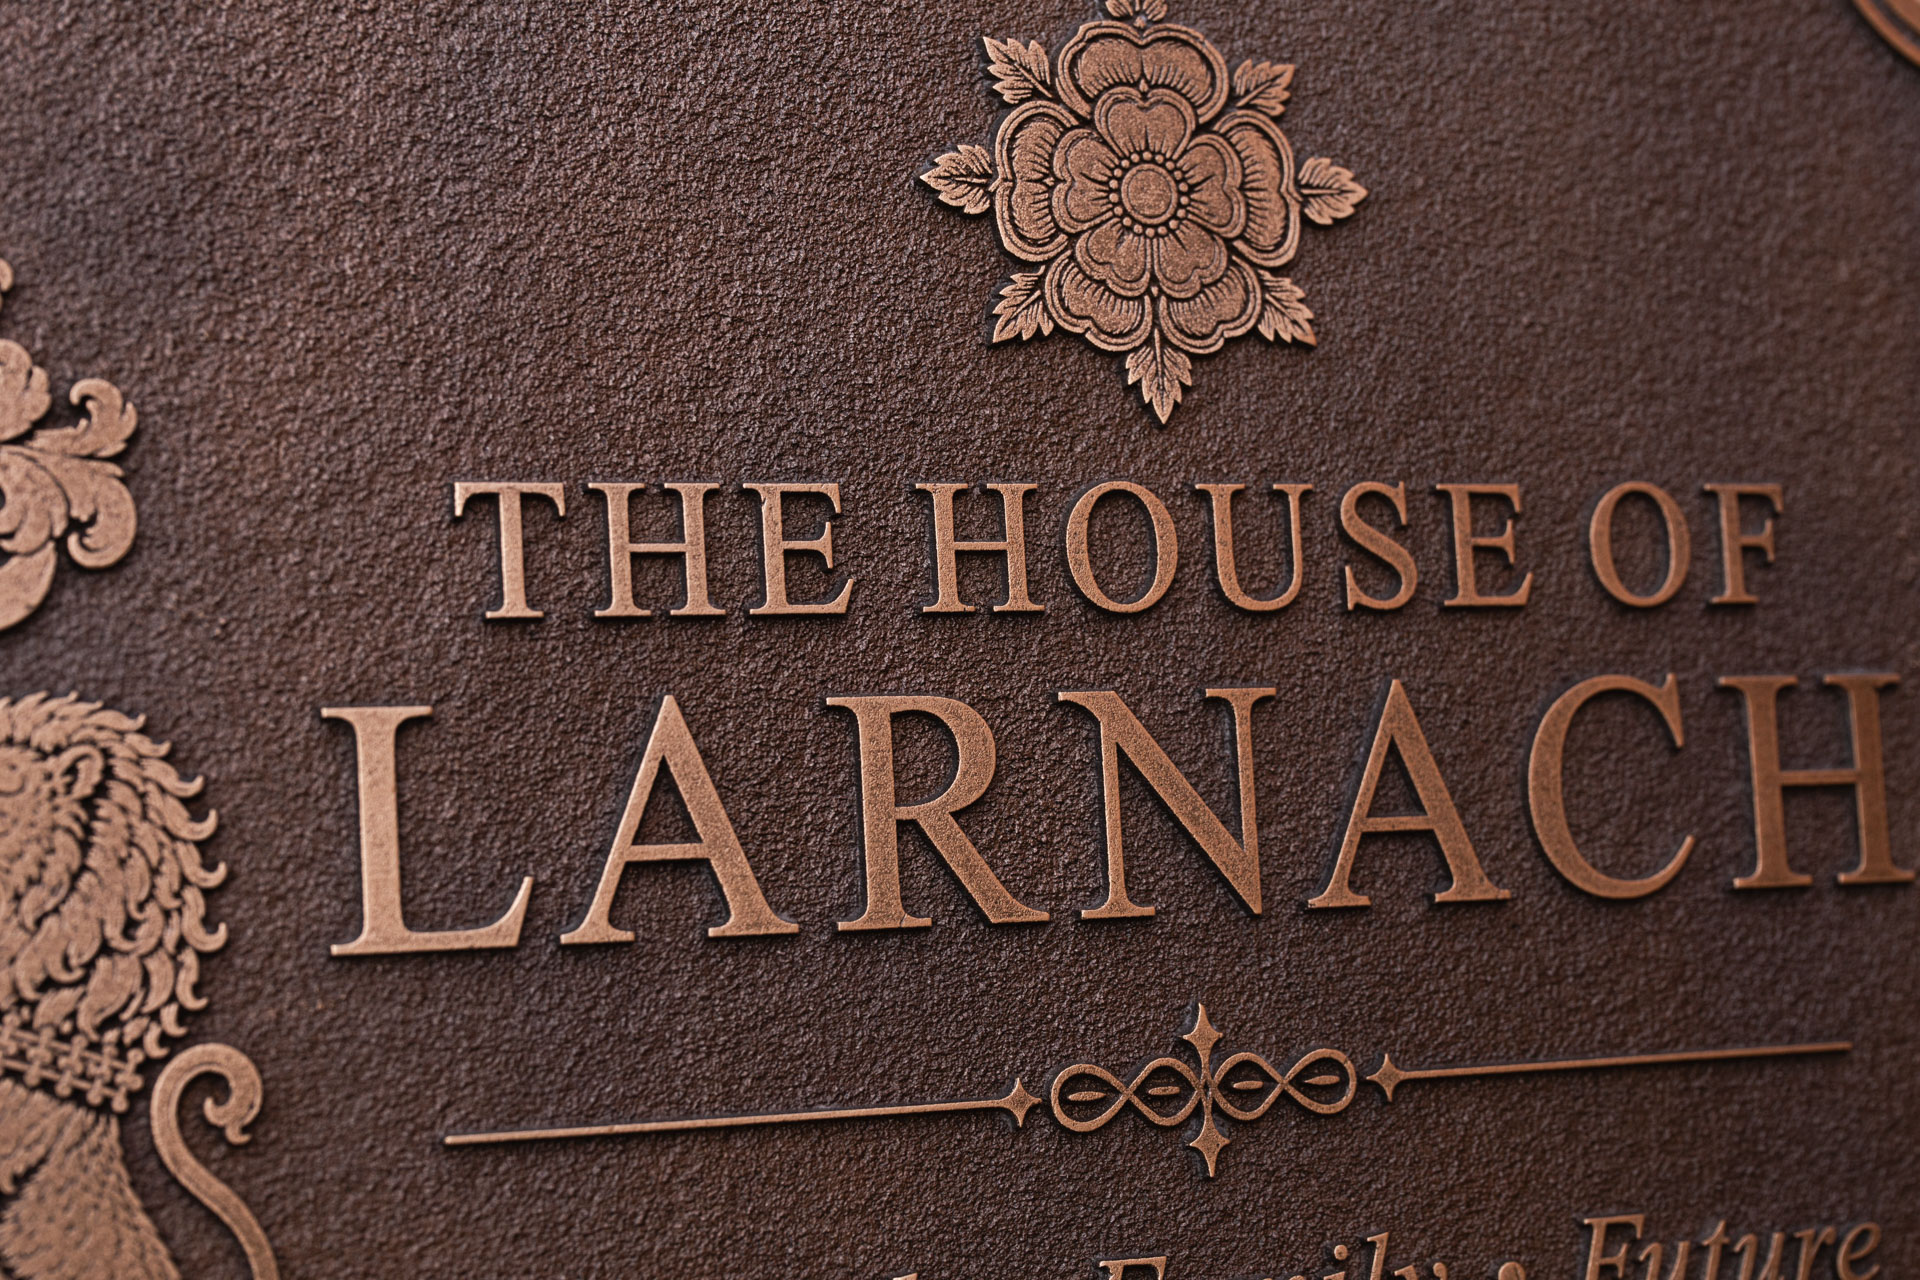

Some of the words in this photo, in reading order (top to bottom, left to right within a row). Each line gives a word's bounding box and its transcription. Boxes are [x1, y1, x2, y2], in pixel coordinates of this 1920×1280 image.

[454, 482, 853, 620] THE
[916, 481, 1533, 614] HOUSE
[1589, 481, 1784, 607] OF
[320, 672, 1916, 957] LARNACH
[1583, 1213, 1882, 1280] Future
